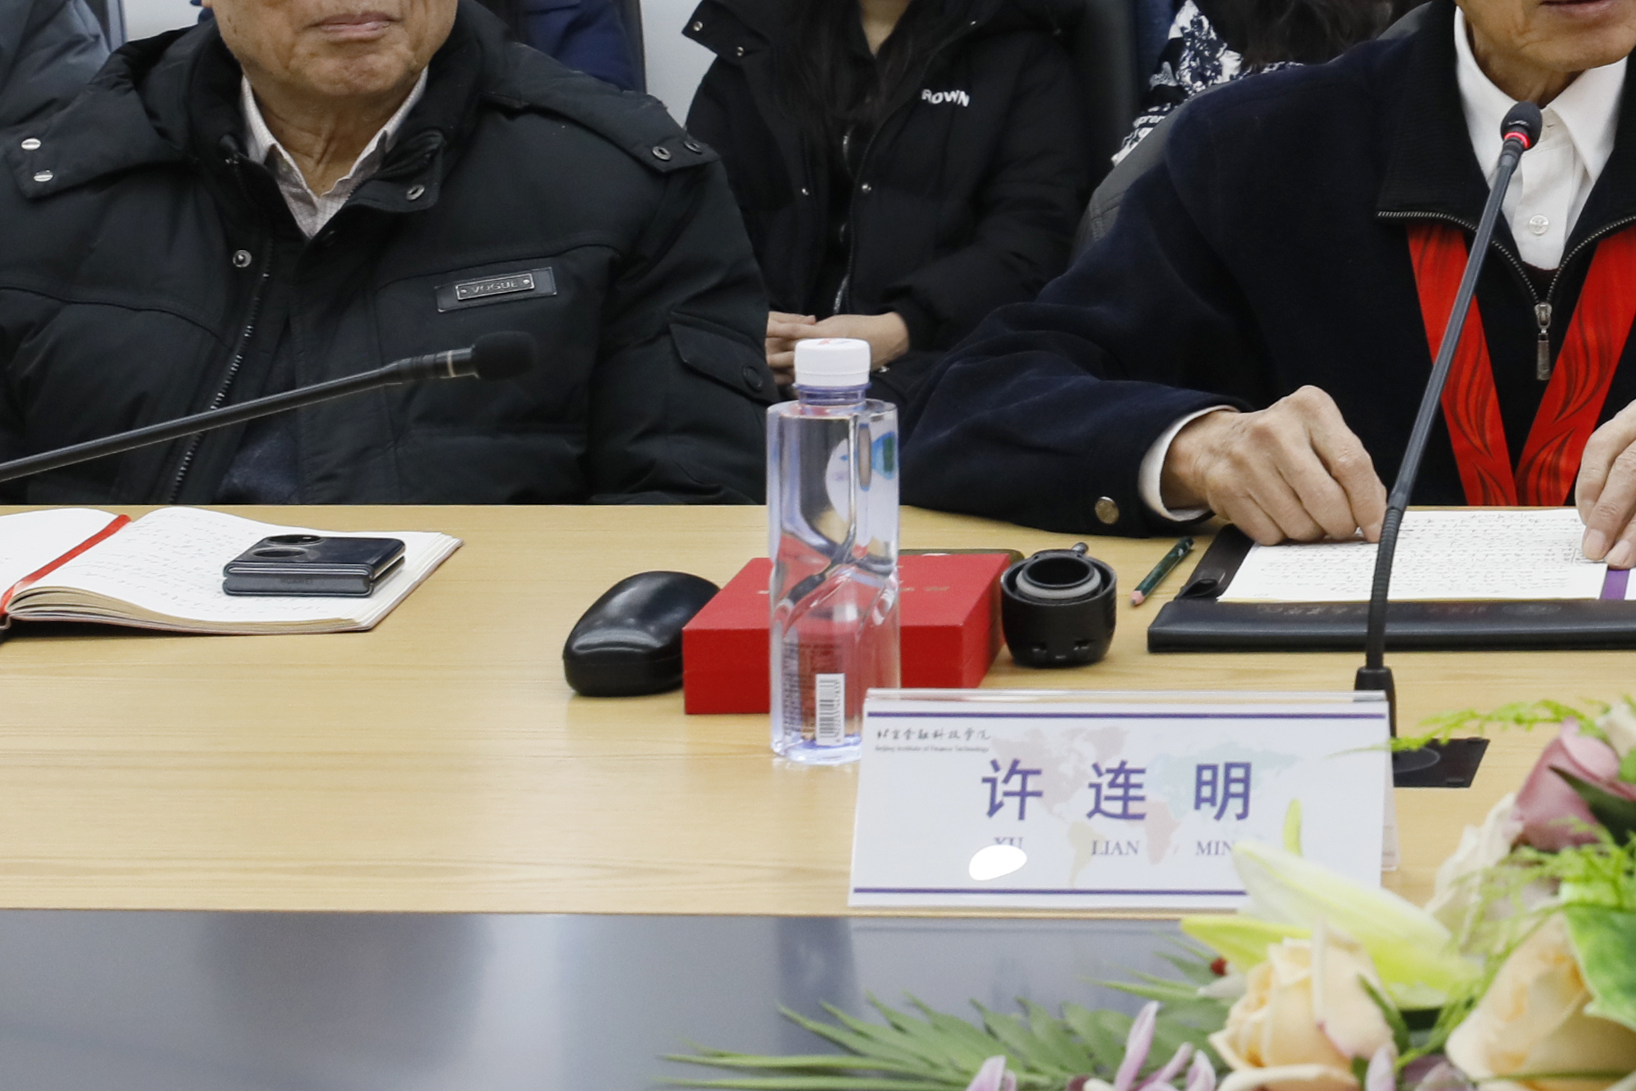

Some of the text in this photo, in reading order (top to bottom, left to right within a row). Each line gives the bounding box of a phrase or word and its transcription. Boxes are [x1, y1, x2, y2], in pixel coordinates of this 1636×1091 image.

[921, 89, 970, 107] ROWN
[471, 280, 518, 294] VOGUE
[981, 758, 1252, 821] 许连明
[1091, 840, 1140, 856] LIAN
[1195, 840, 1236, 856] MIN
